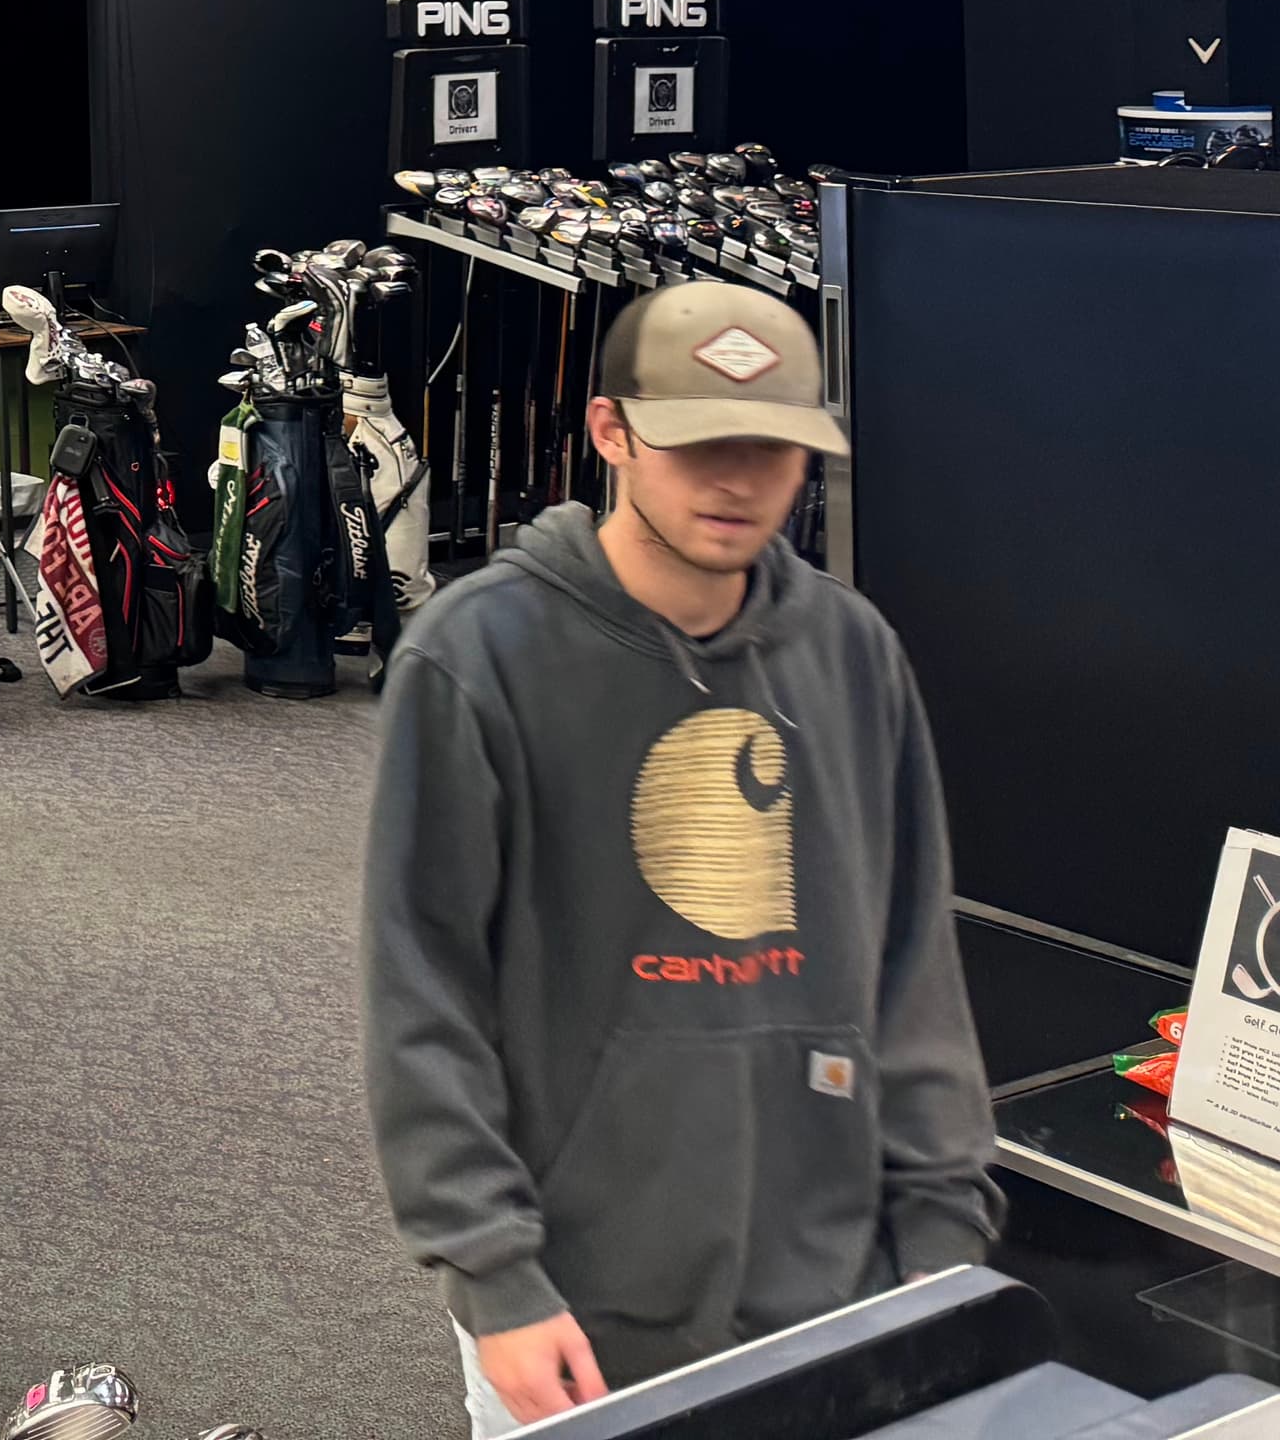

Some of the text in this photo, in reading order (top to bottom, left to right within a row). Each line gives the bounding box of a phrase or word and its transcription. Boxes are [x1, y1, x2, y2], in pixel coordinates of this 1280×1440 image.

[417, 1, 510, 37] PING
[449, 124, 478, 135] Drivers
[648, 117, 676, 128] Drivers
[340, 501, 371, 579] Titleist
[1243, 1014, 1266, 1030] Golf
